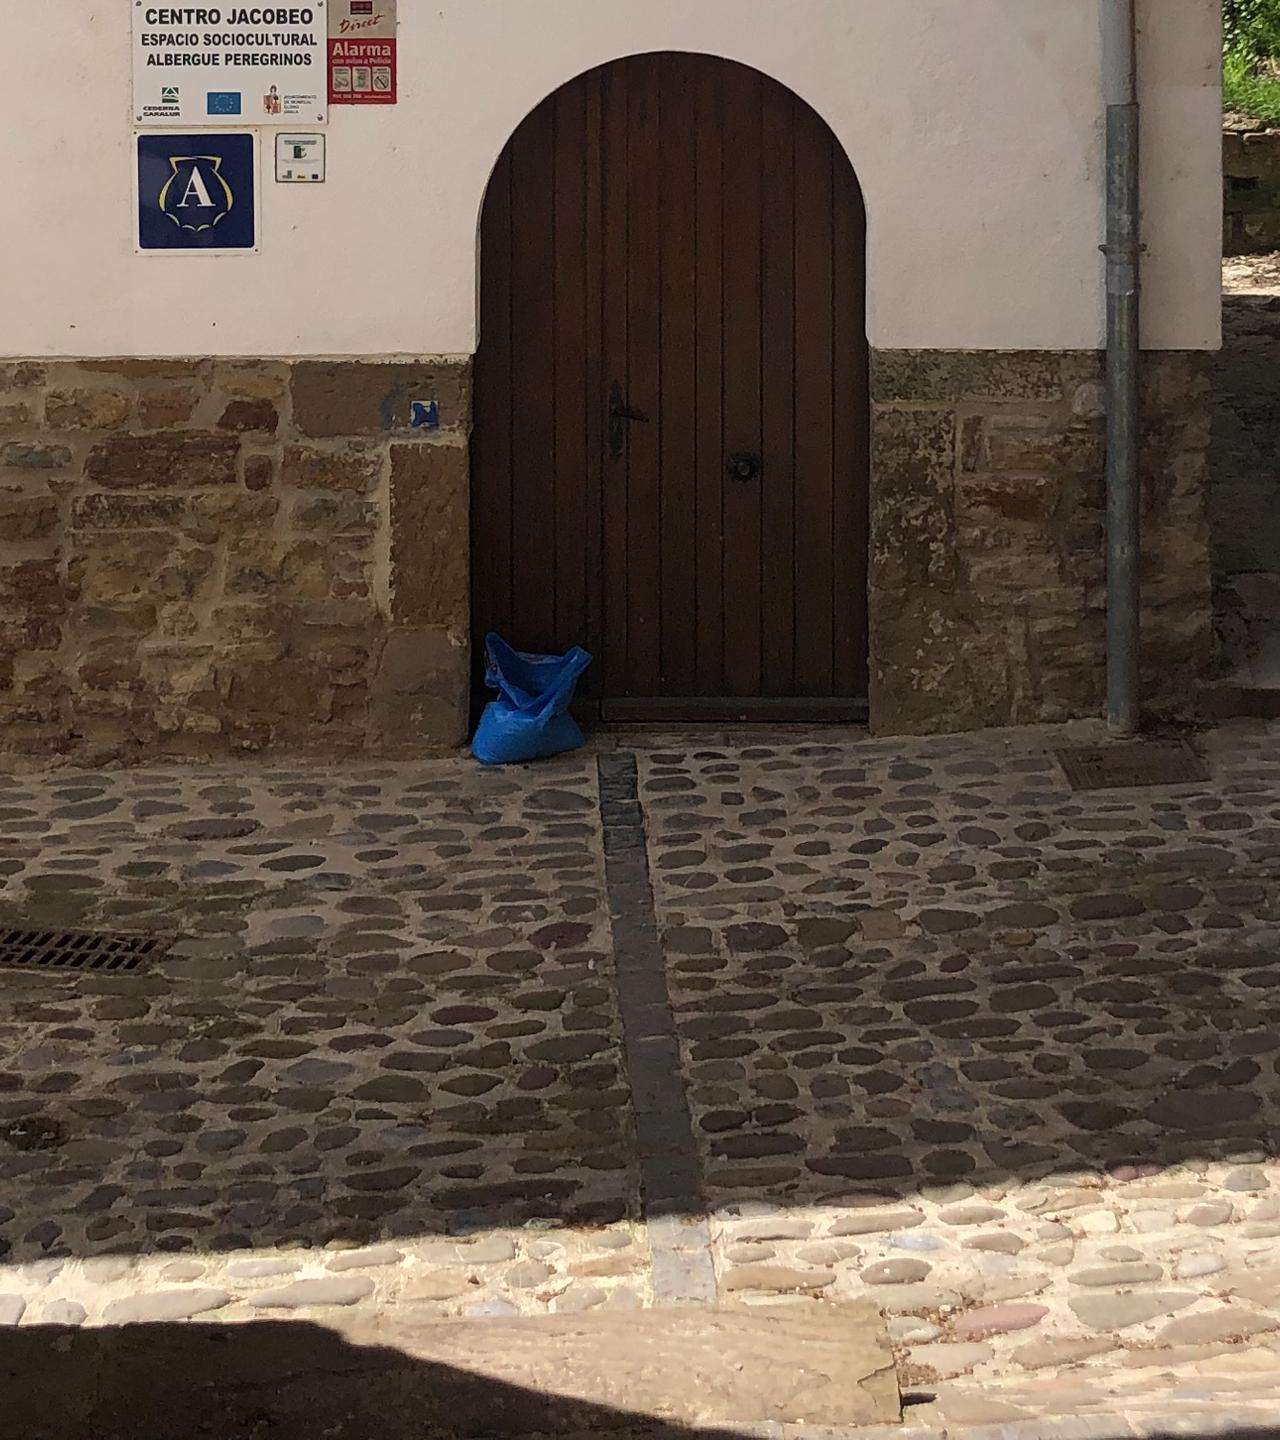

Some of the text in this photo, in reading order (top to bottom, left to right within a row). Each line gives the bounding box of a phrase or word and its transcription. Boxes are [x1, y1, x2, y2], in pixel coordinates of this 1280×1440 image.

[145, 8, 313, 25] CENTRO JACOBEO
[339, 14, 385, 34] Direct
[141, 33, 317, 46] ESPACIO SOCIOCULTURAL
[332, 41, 391, 56] Alarma
[146, 53, 312, 66] ALBERGUE PEREGRINOS
[176, 166, 216, 207] A
